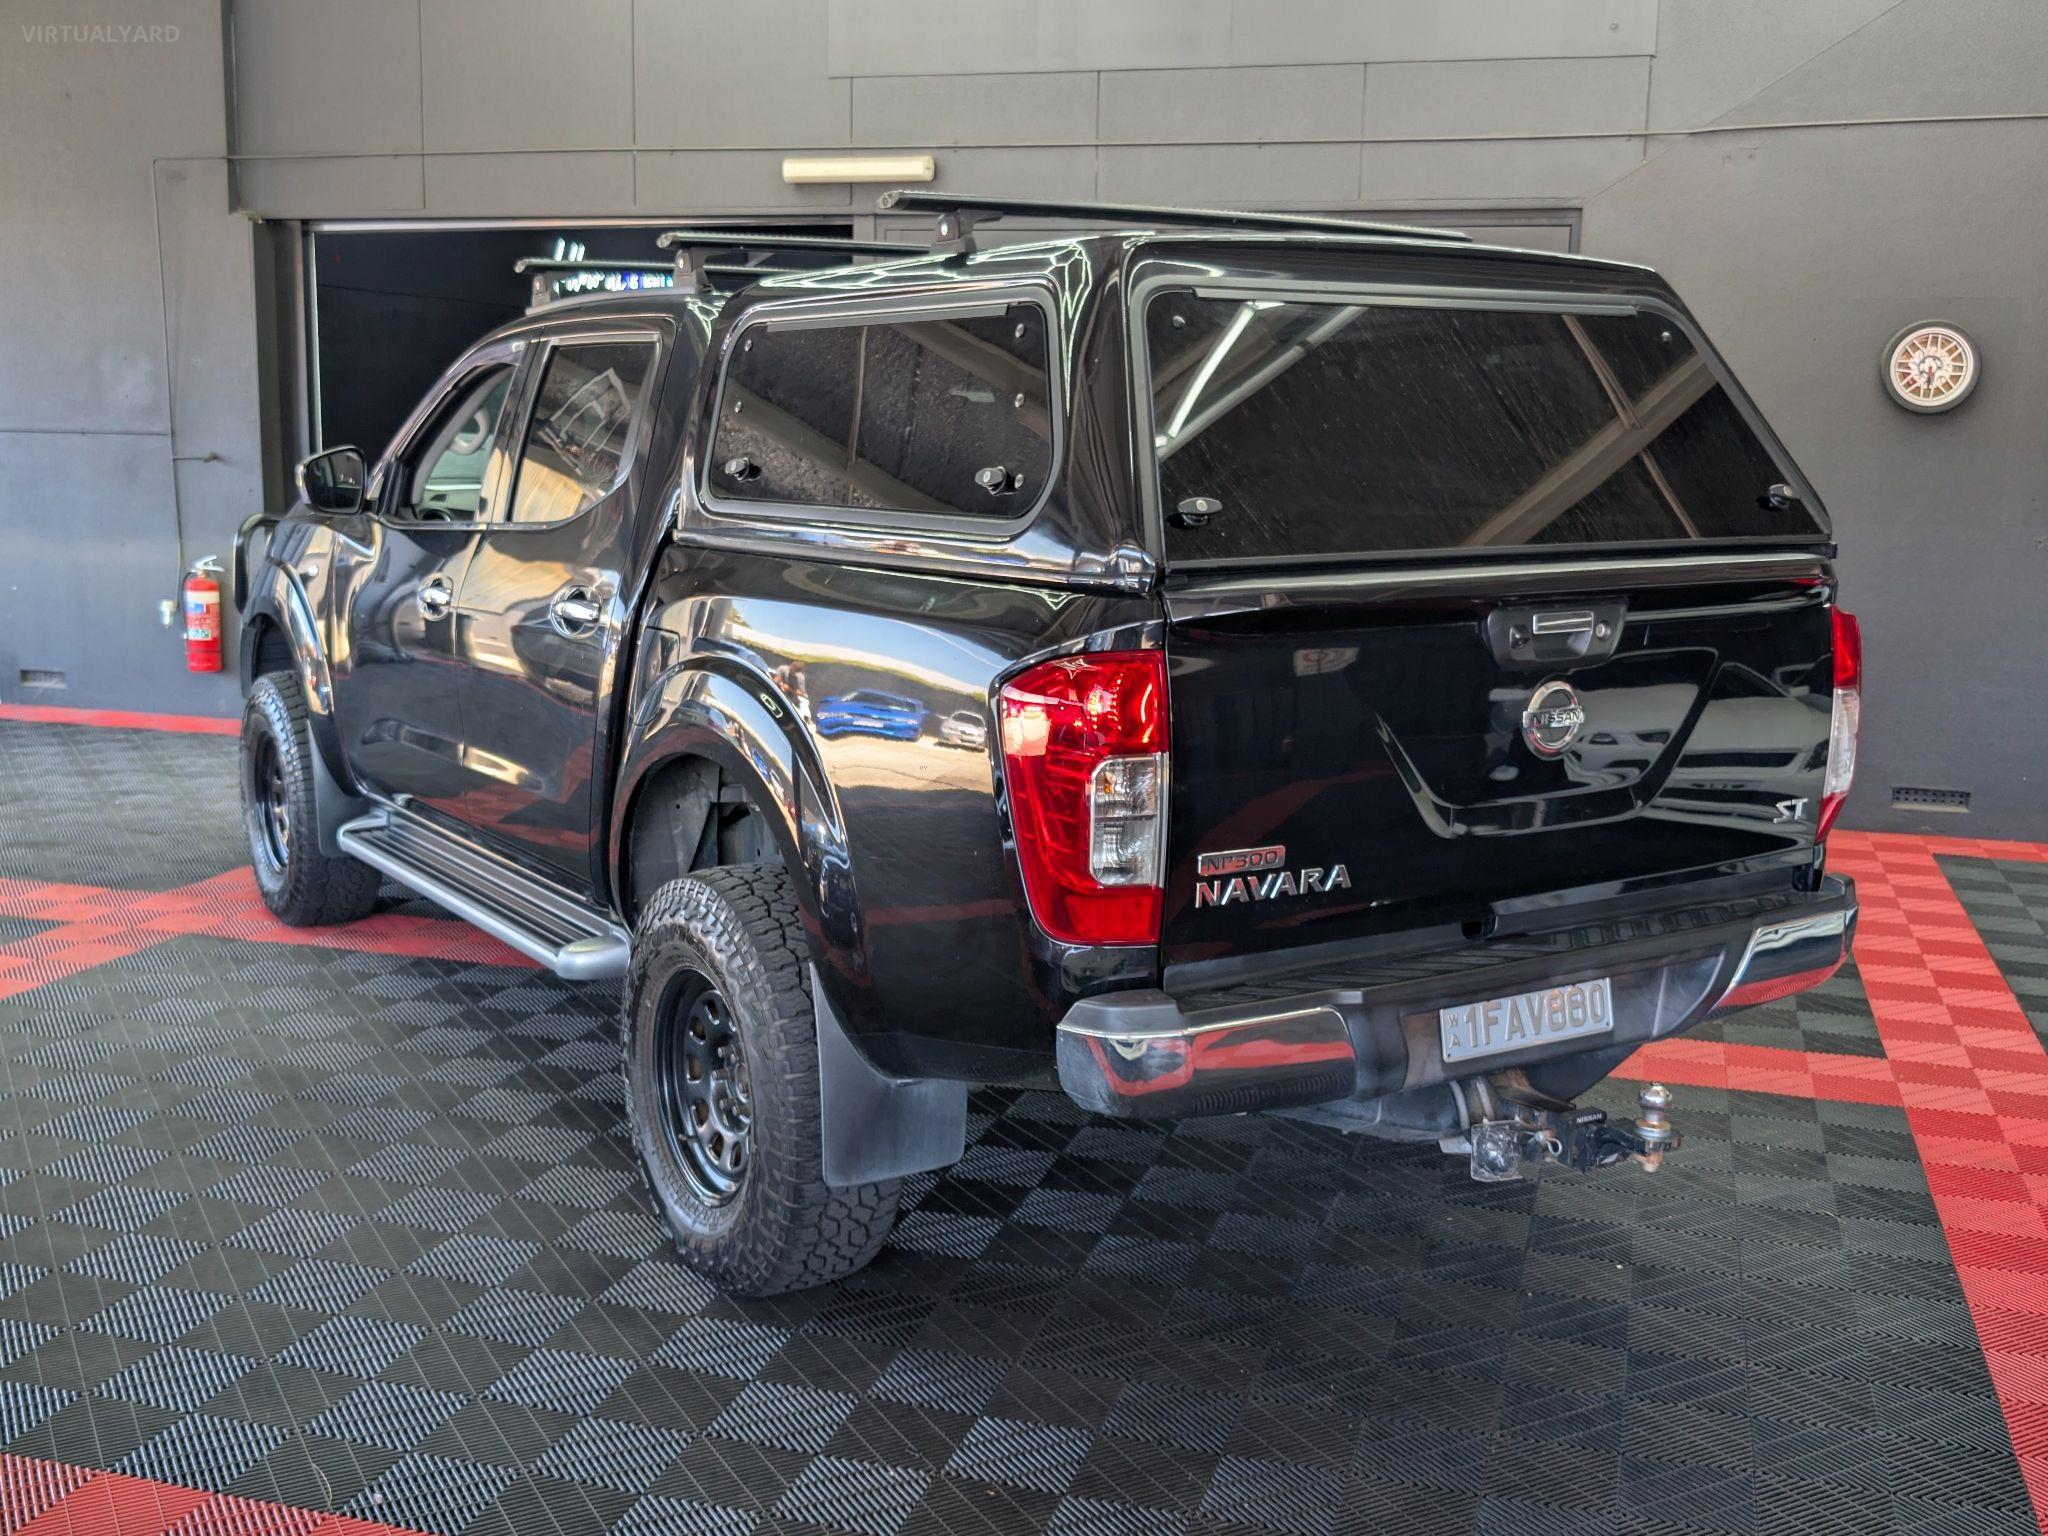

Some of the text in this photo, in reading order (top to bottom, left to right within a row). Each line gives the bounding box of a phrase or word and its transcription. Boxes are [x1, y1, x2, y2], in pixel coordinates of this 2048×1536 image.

[1532, 710, 1580, 724] NISSAN
[1206, 850, 1278, 871] NP300
[1195, 864, 1352, 909] NAVARA
[1464, 984, 1605, 1047] 1FAV880
